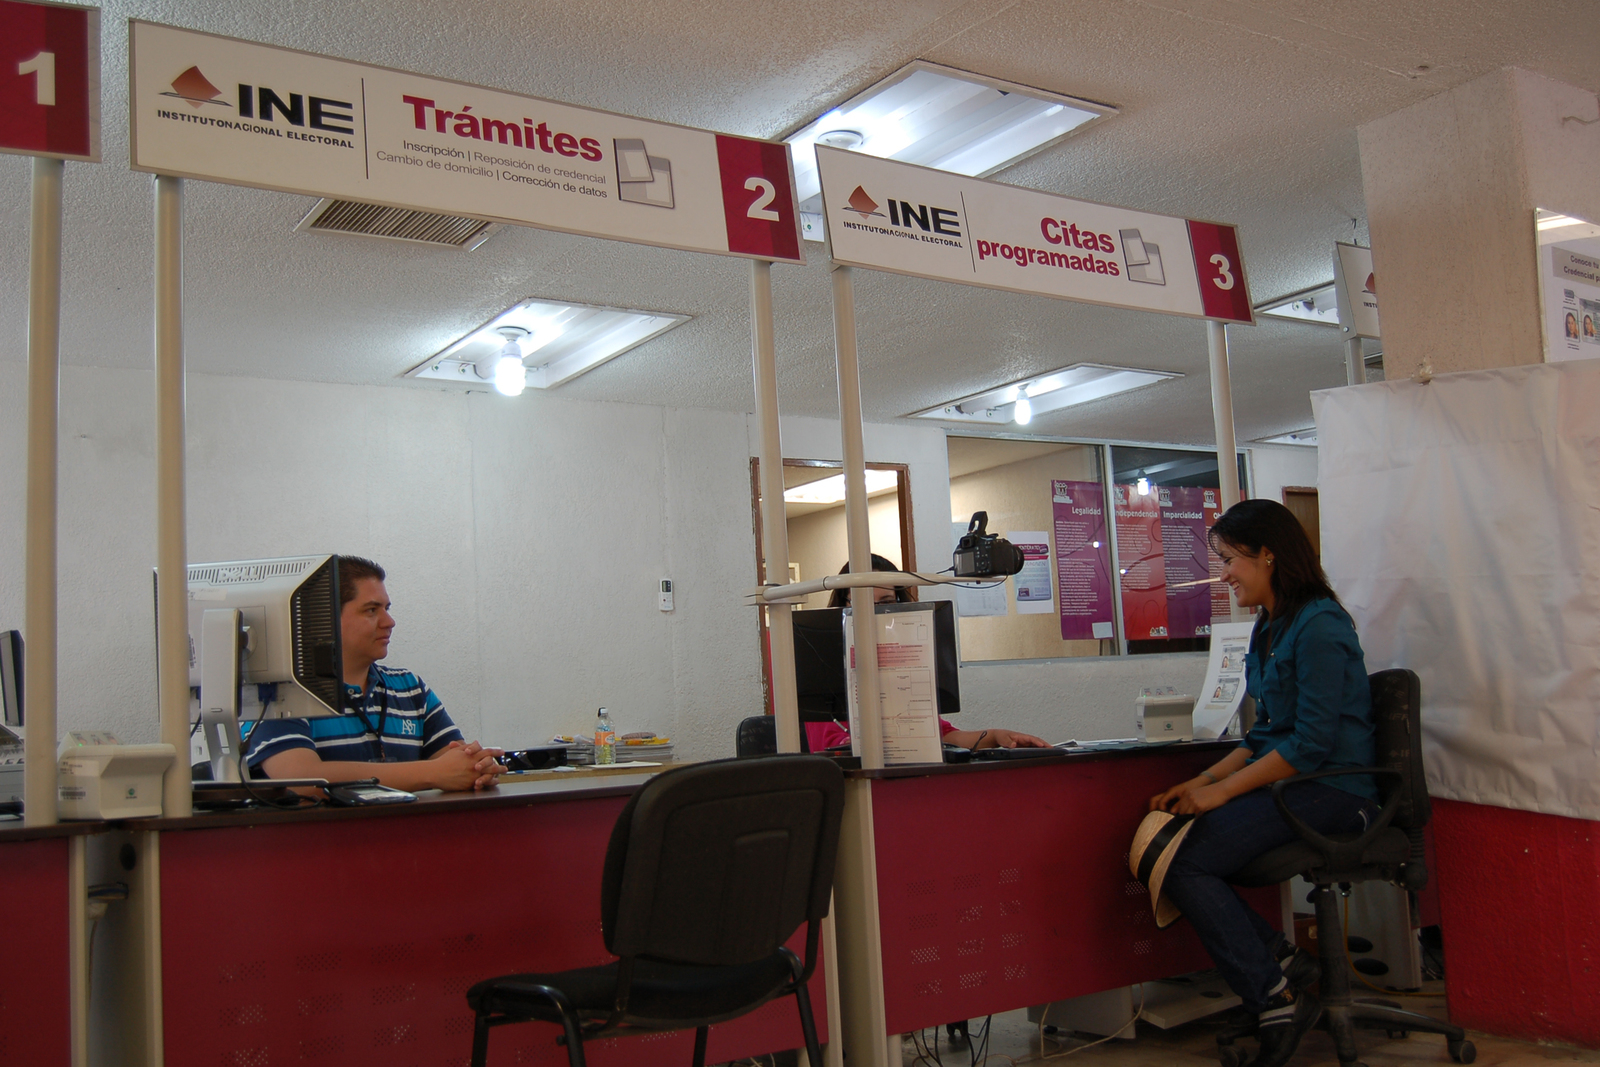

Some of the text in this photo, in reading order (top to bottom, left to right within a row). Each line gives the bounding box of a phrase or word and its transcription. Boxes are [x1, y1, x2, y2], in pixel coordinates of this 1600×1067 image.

[18, 51, 56, 106] 1
[238, 83, 354, 135] INE
[286, 130, 354, 149] ELECTORAL
[402, 94, 603, 162] Trámites
[376, 150, 607, 198] Cambio de domicilio Corrección de datos
[403, 139, 606, 184] Inscripción Reposición de credencial
[744, 176, 780, 222] 2
[887, 198, 962, 237] INE
[921, 235, 963, 249] ELECTORAL
[1040, 217, 1115, 254] Citas
[976, 239, 1120, 276] programadas
[1209, 253, 1234, 290] 3
[1563, 265, 1595, 280] Credencial
[1570, 254, 1592, 267] Conoce
[1071, 506, 1101, 516] Legalidad
[1115, 510, 1158, 519] ndependencia
[1163, 511, 1203, 520] Imparcialidad
